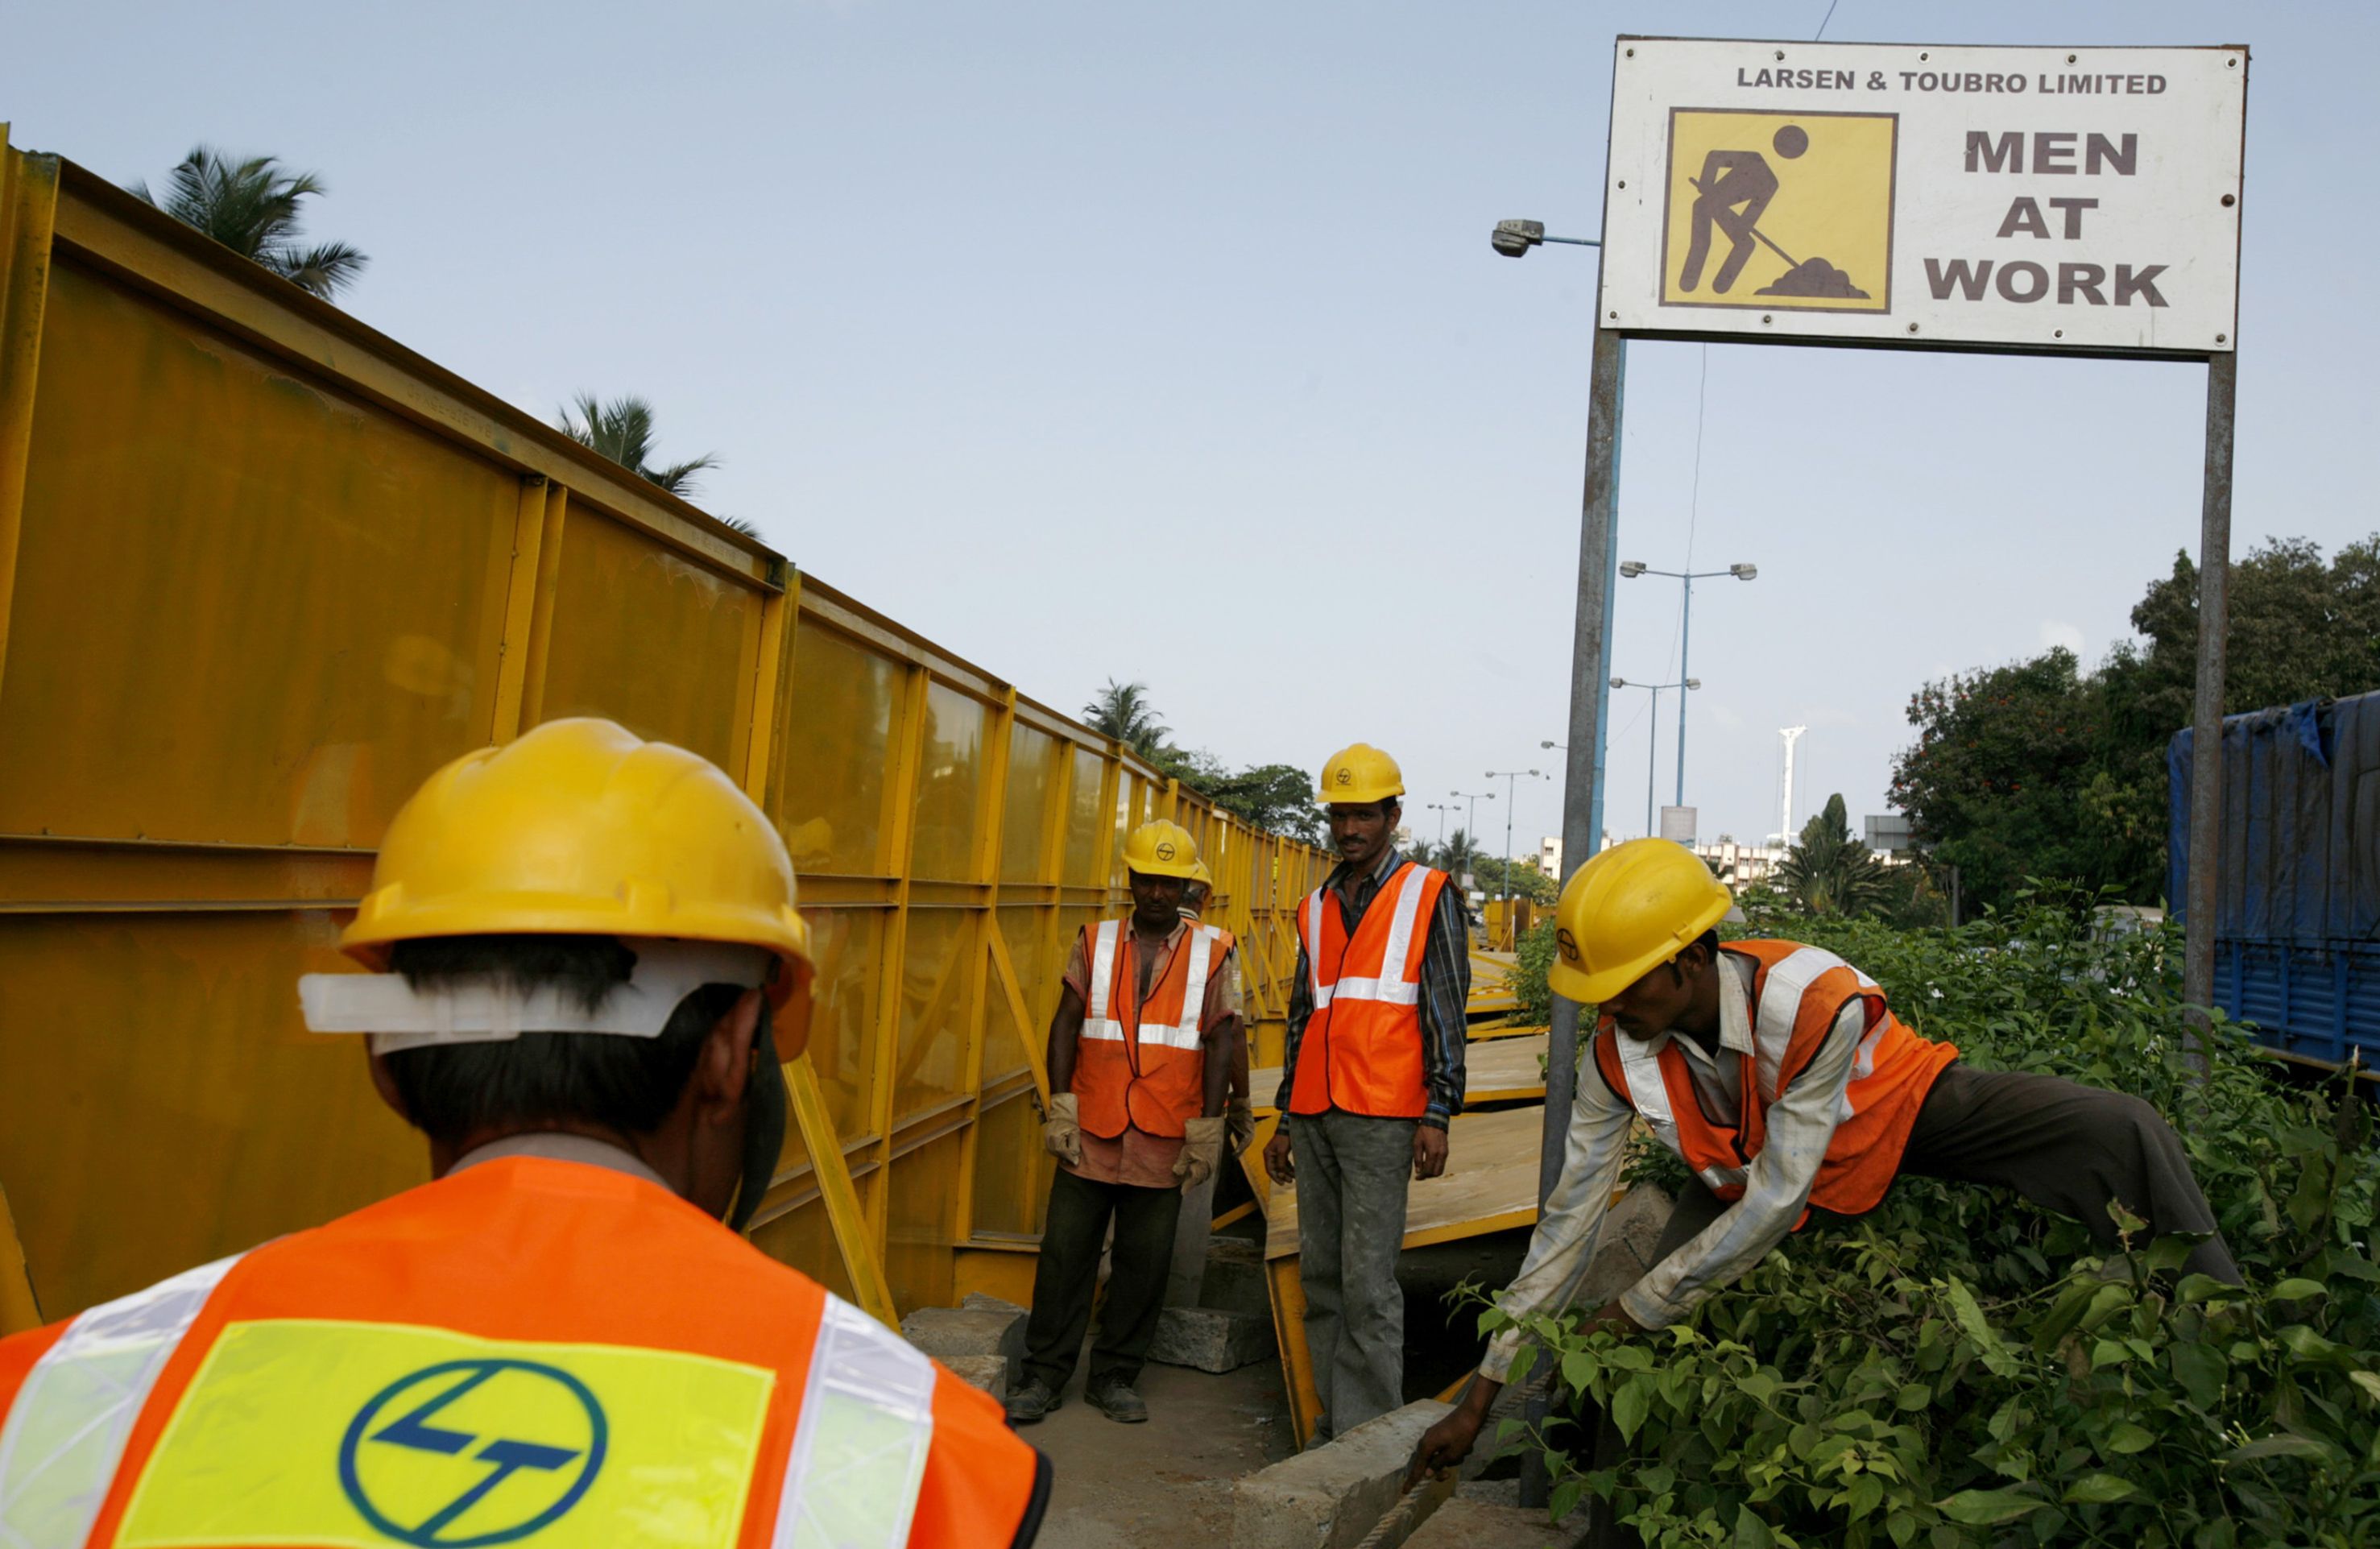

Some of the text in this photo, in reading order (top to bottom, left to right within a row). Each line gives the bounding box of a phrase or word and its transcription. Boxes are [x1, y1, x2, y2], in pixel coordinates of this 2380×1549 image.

[1737, 68, 2167, 94] LARSEN & TOUBRO LIMITED
[1964, 130, 2138, 176] MEN
[1996, 197, 2098, 239] AT
[1923, 258, 2170, 308] WORK
